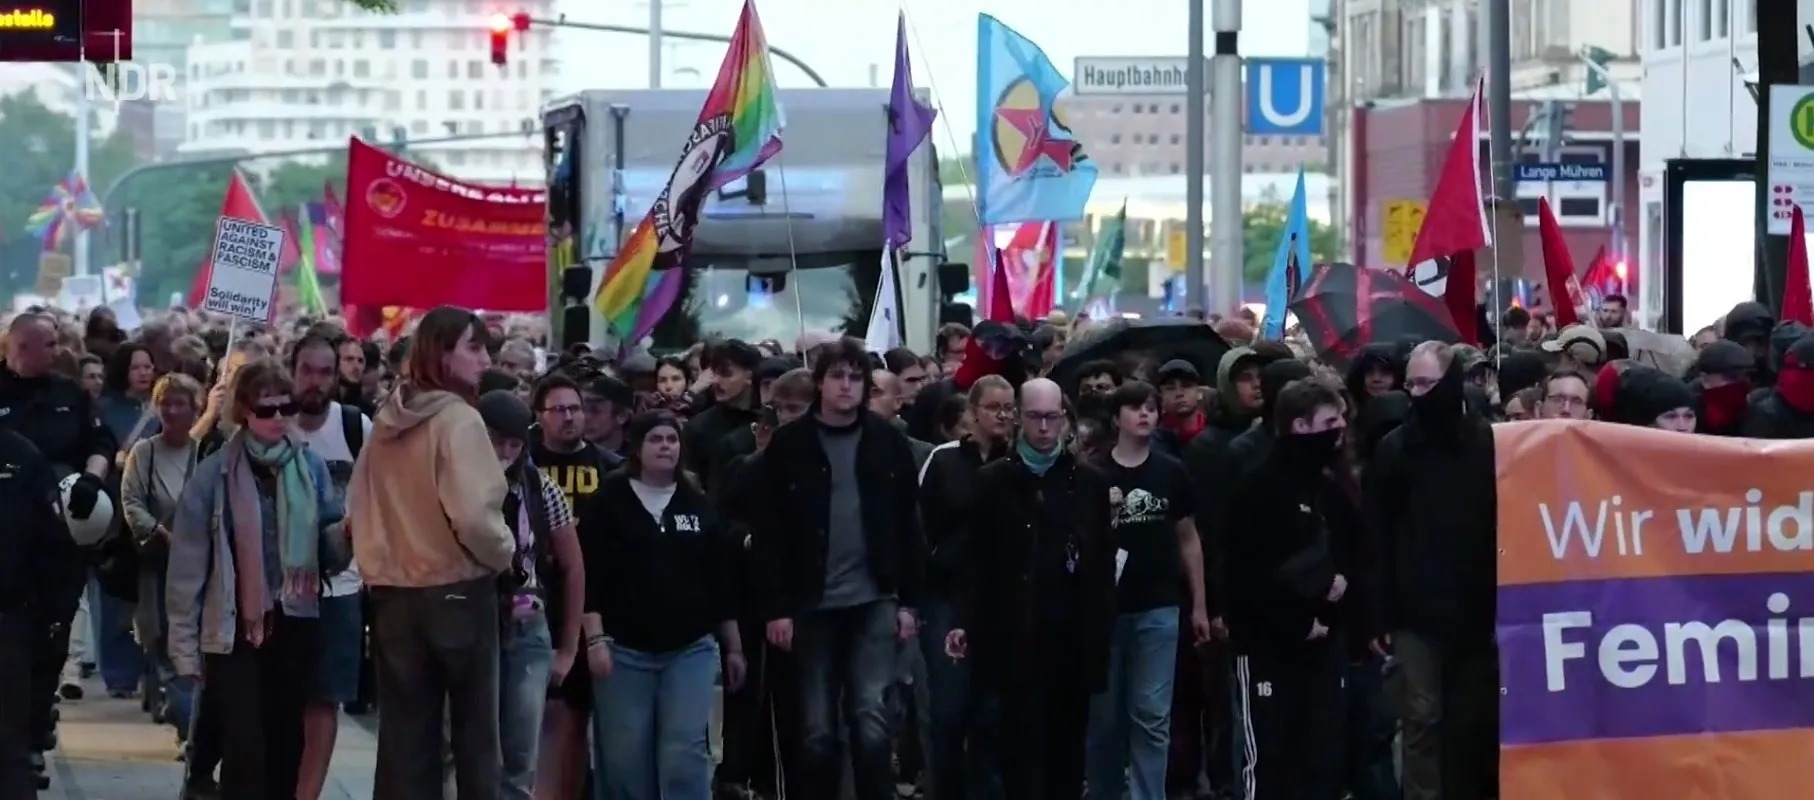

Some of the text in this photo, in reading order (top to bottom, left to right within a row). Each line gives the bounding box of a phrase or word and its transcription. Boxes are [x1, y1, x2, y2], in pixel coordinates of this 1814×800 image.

[1260, 64, 1312, 126] U
[1520, 164, 1604, 180] Lange Mühren
[223, 223, 268, 239] UNITED
[218, 241, 267, 259] RACISM
[220, 232, 275, 250] AGAINST
[216, 251, 271, 270] FASCISM
[207, 300, 230, 310] will
[210, 287, 268, 309] Solidarity
[1538, 495, 1653, 559] Wir
[1256, 681, 1273, 697] 16
